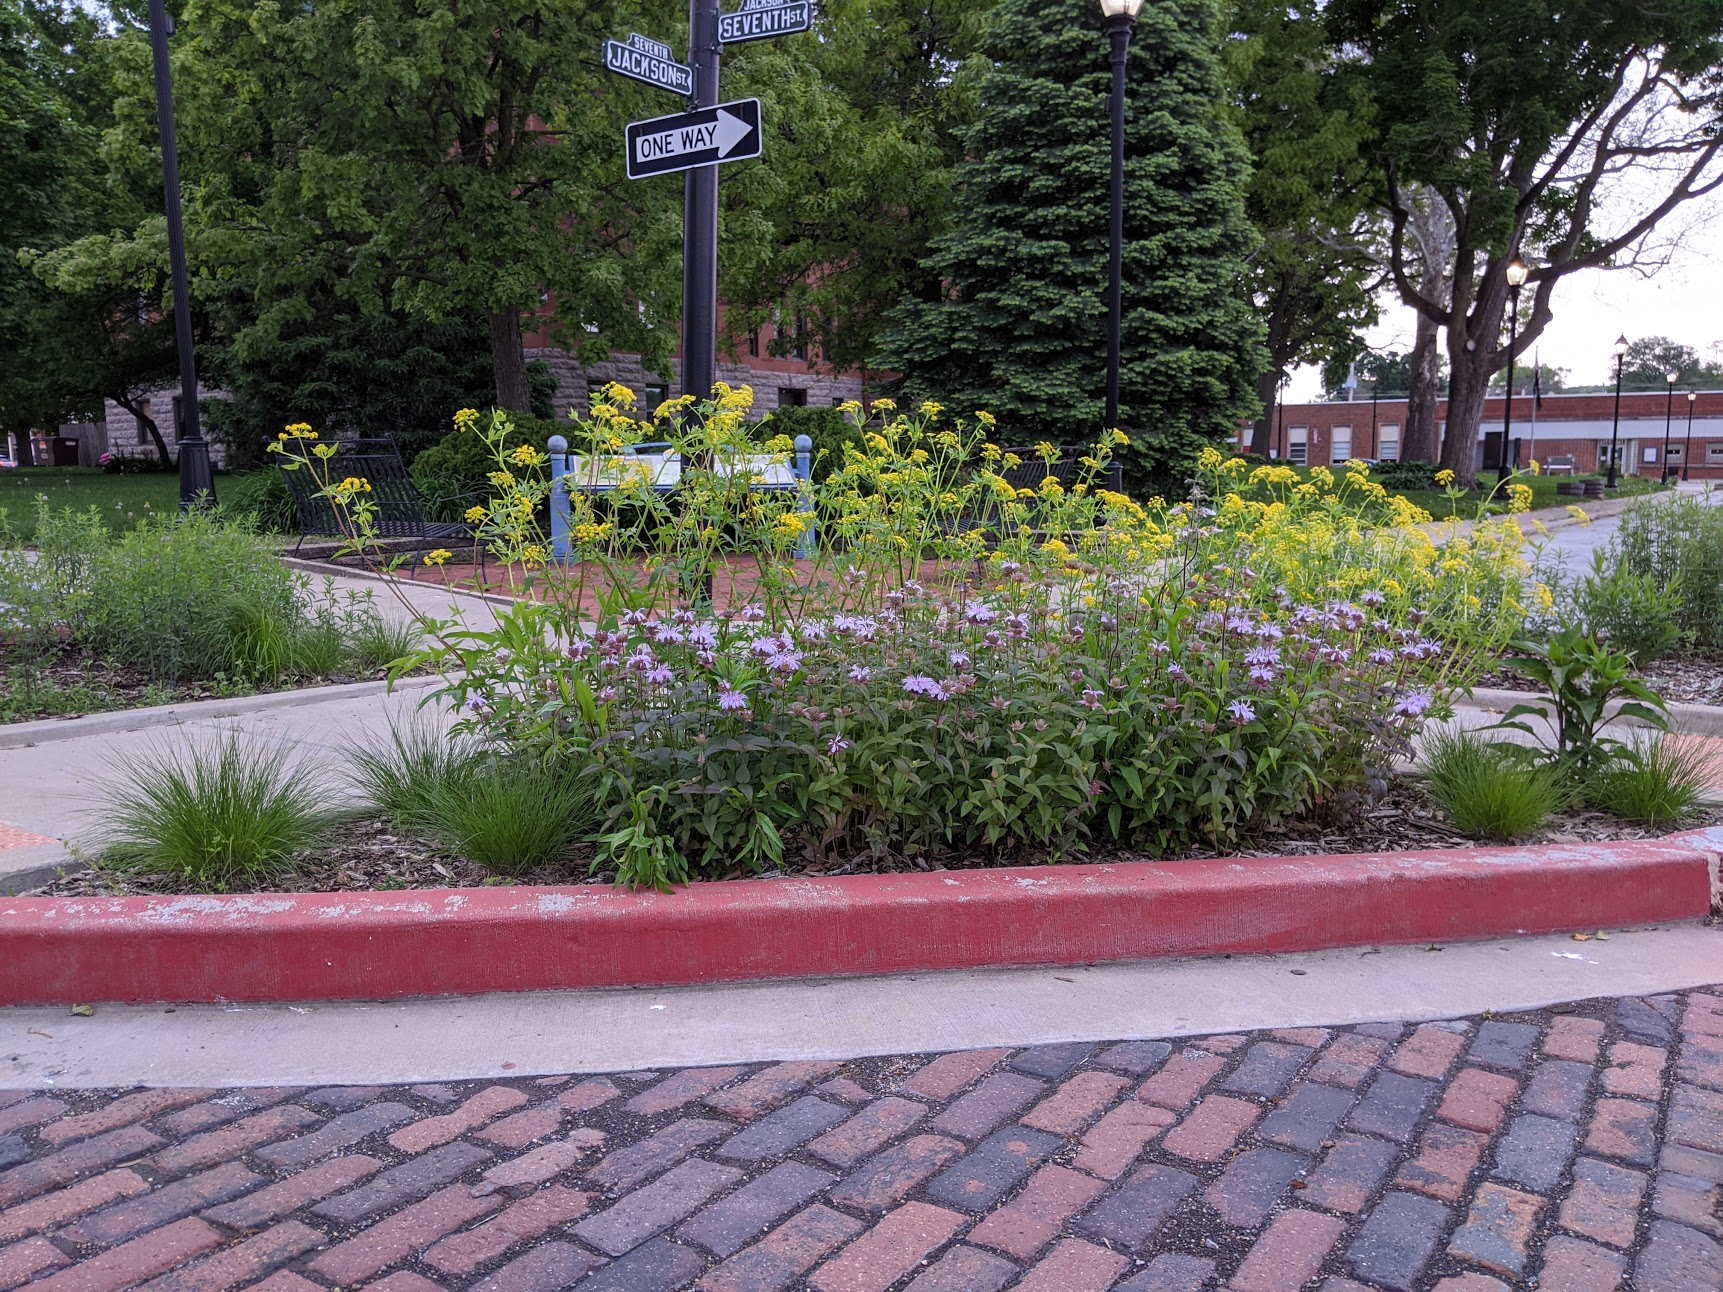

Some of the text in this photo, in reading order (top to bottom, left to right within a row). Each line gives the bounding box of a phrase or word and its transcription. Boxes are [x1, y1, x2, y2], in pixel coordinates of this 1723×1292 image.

[723, 9, 803, 38] SEVENTH ST.
[634, 36, 668, 60] SEVENTH
[613, 47, 688, 86] JACKSON ST.
[640, 124, 717, 158] ONE WAY
